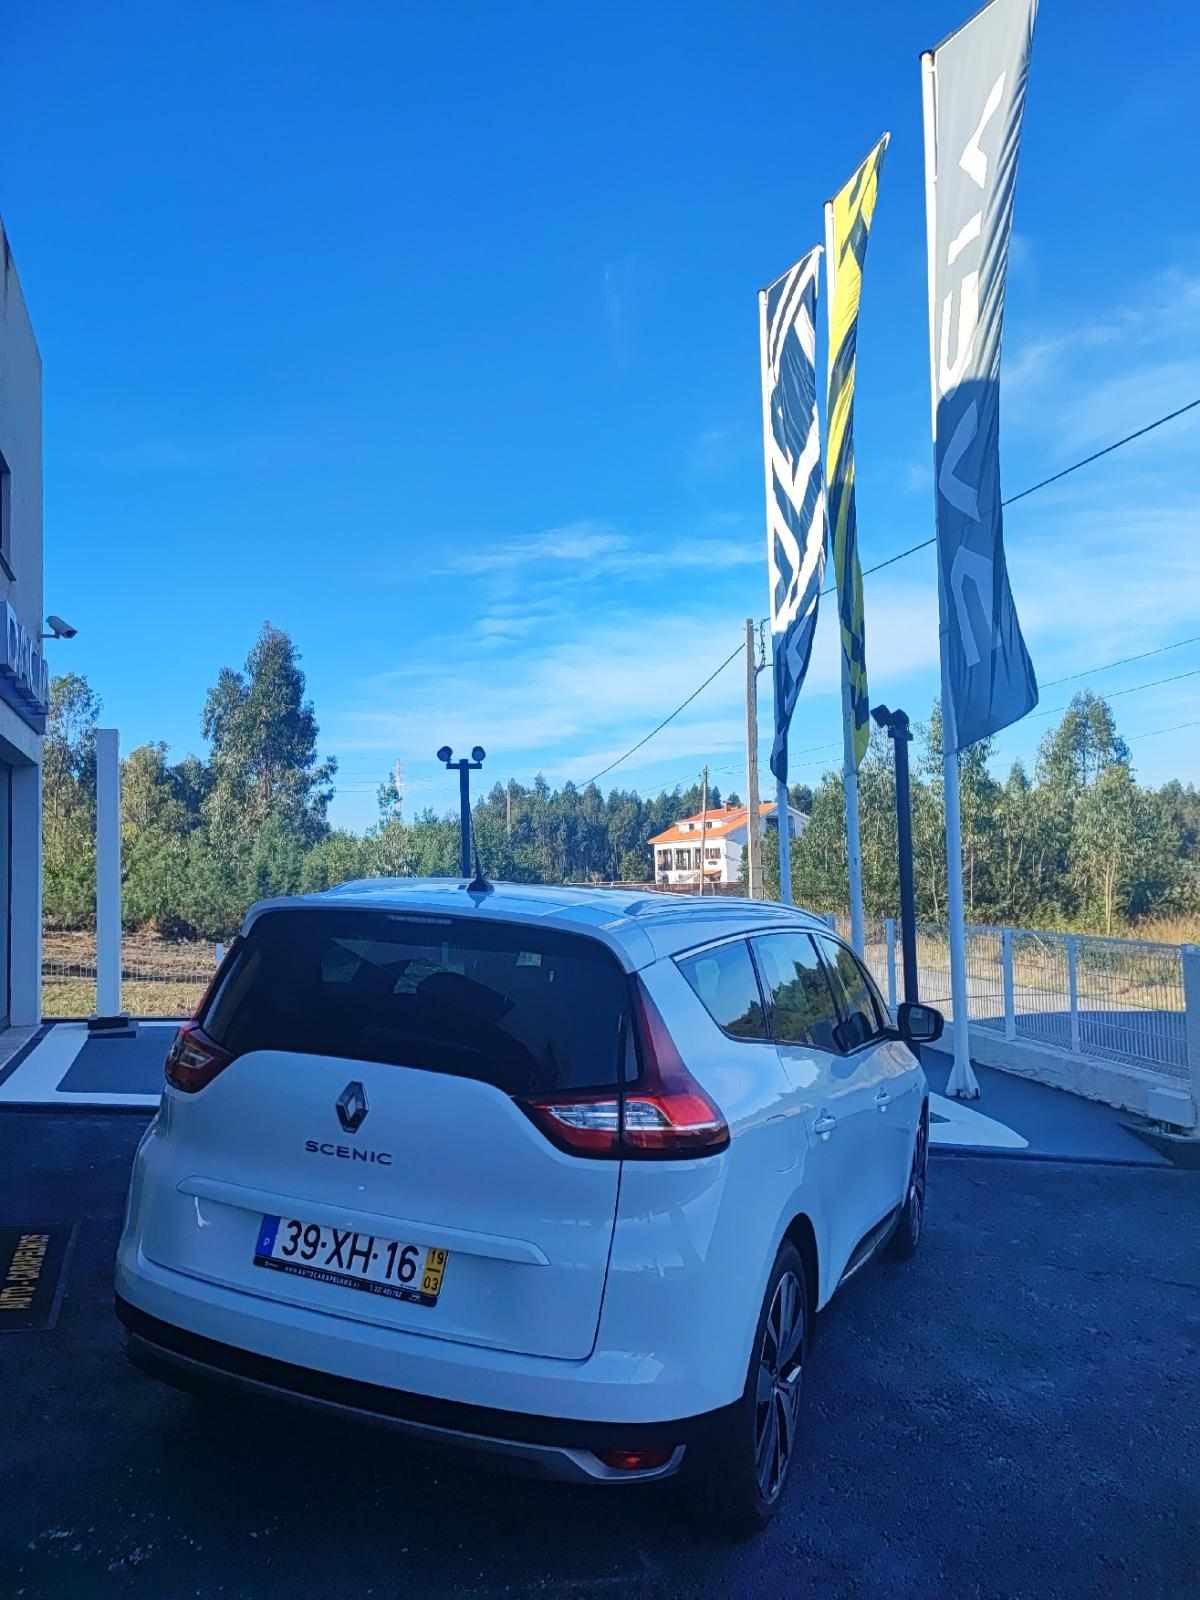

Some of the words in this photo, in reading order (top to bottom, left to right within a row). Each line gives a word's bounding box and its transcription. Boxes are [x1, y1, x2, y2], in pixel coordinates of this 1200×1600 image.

[304, 1139, 393, 1166] SCENIC
[429, 1249, 444, 1265] 19
[423, 1275, 439, 1291] 03
